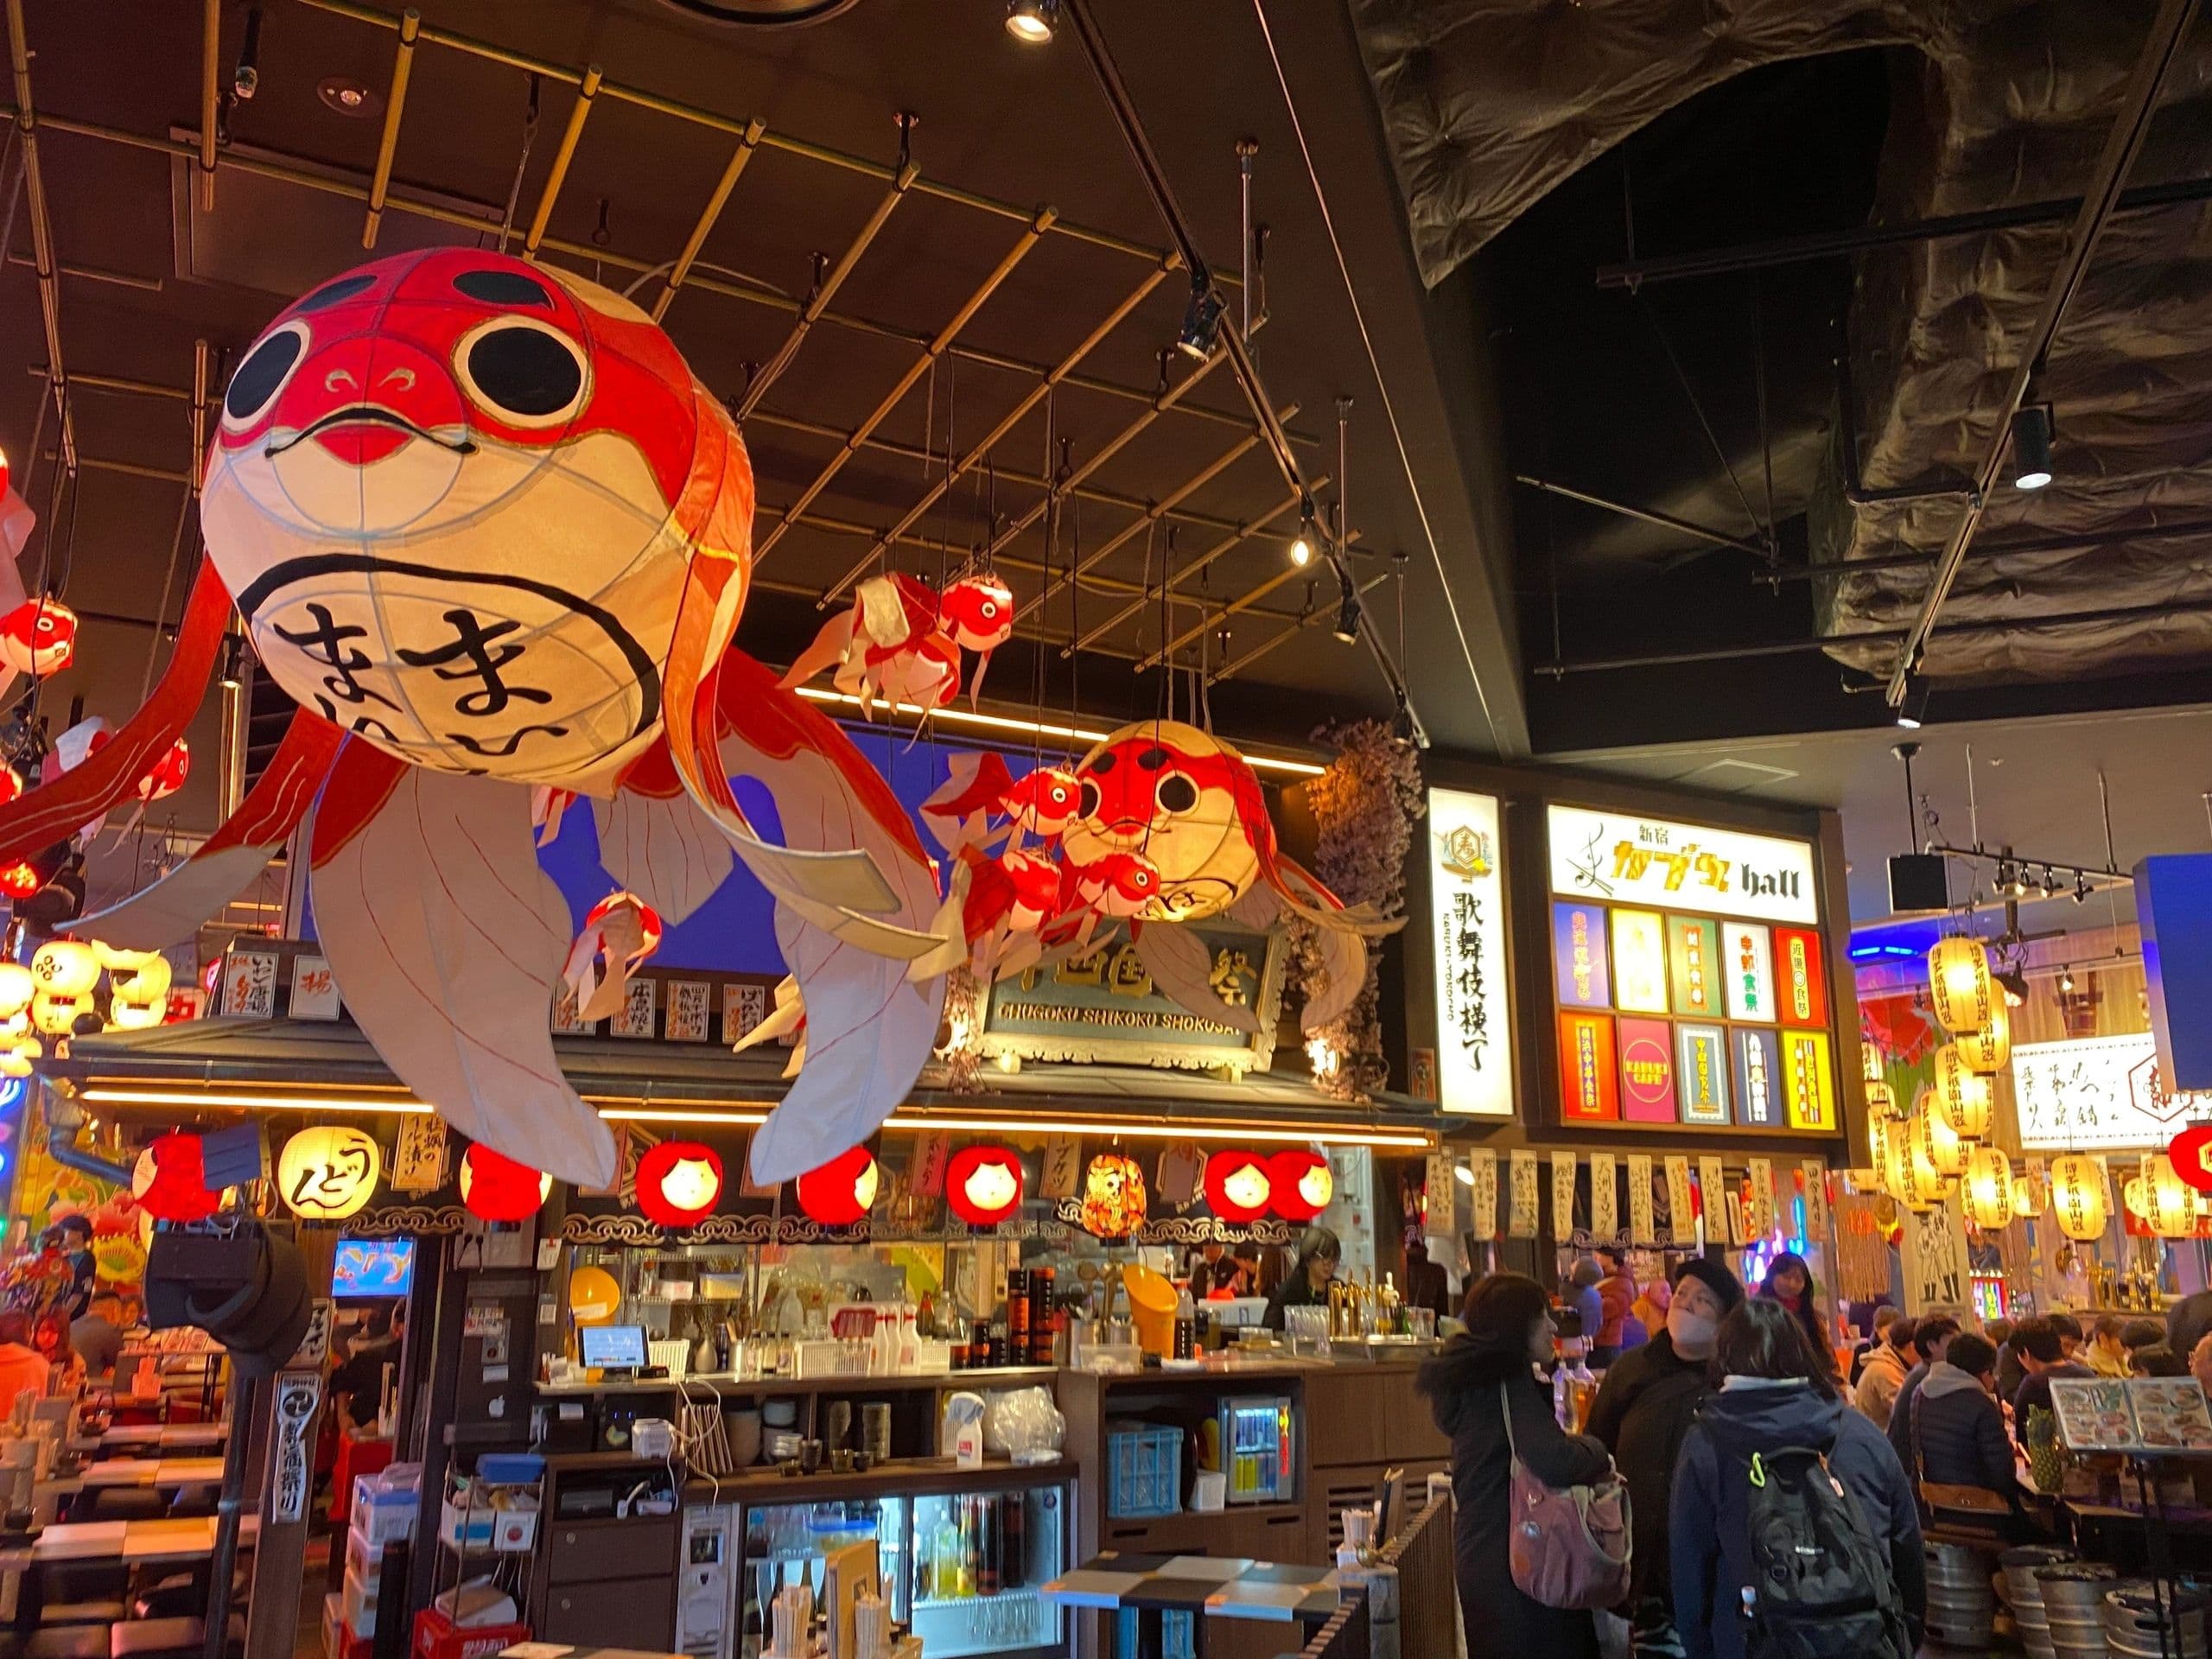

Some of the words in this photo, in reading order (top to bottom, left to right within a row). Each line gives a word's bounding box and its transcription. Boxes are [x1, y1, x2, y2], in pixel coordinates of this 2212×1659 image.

[1638, 824, 1669, 845] 新宿
[1741, 863, 1799, 899] hall
[1452, 893, 1488, 1072] 歌舞伎横丁
[1740, 935, 1758, 1012] 中部食祭
[998, 1001, 1079, 1023] CHUGOKU
[1083, 1008, 1158, 1028] SHIKOKU
[1625, 1060, 1668, 1075] KABUKI
[292, 1137, 372, 1208] うどん
